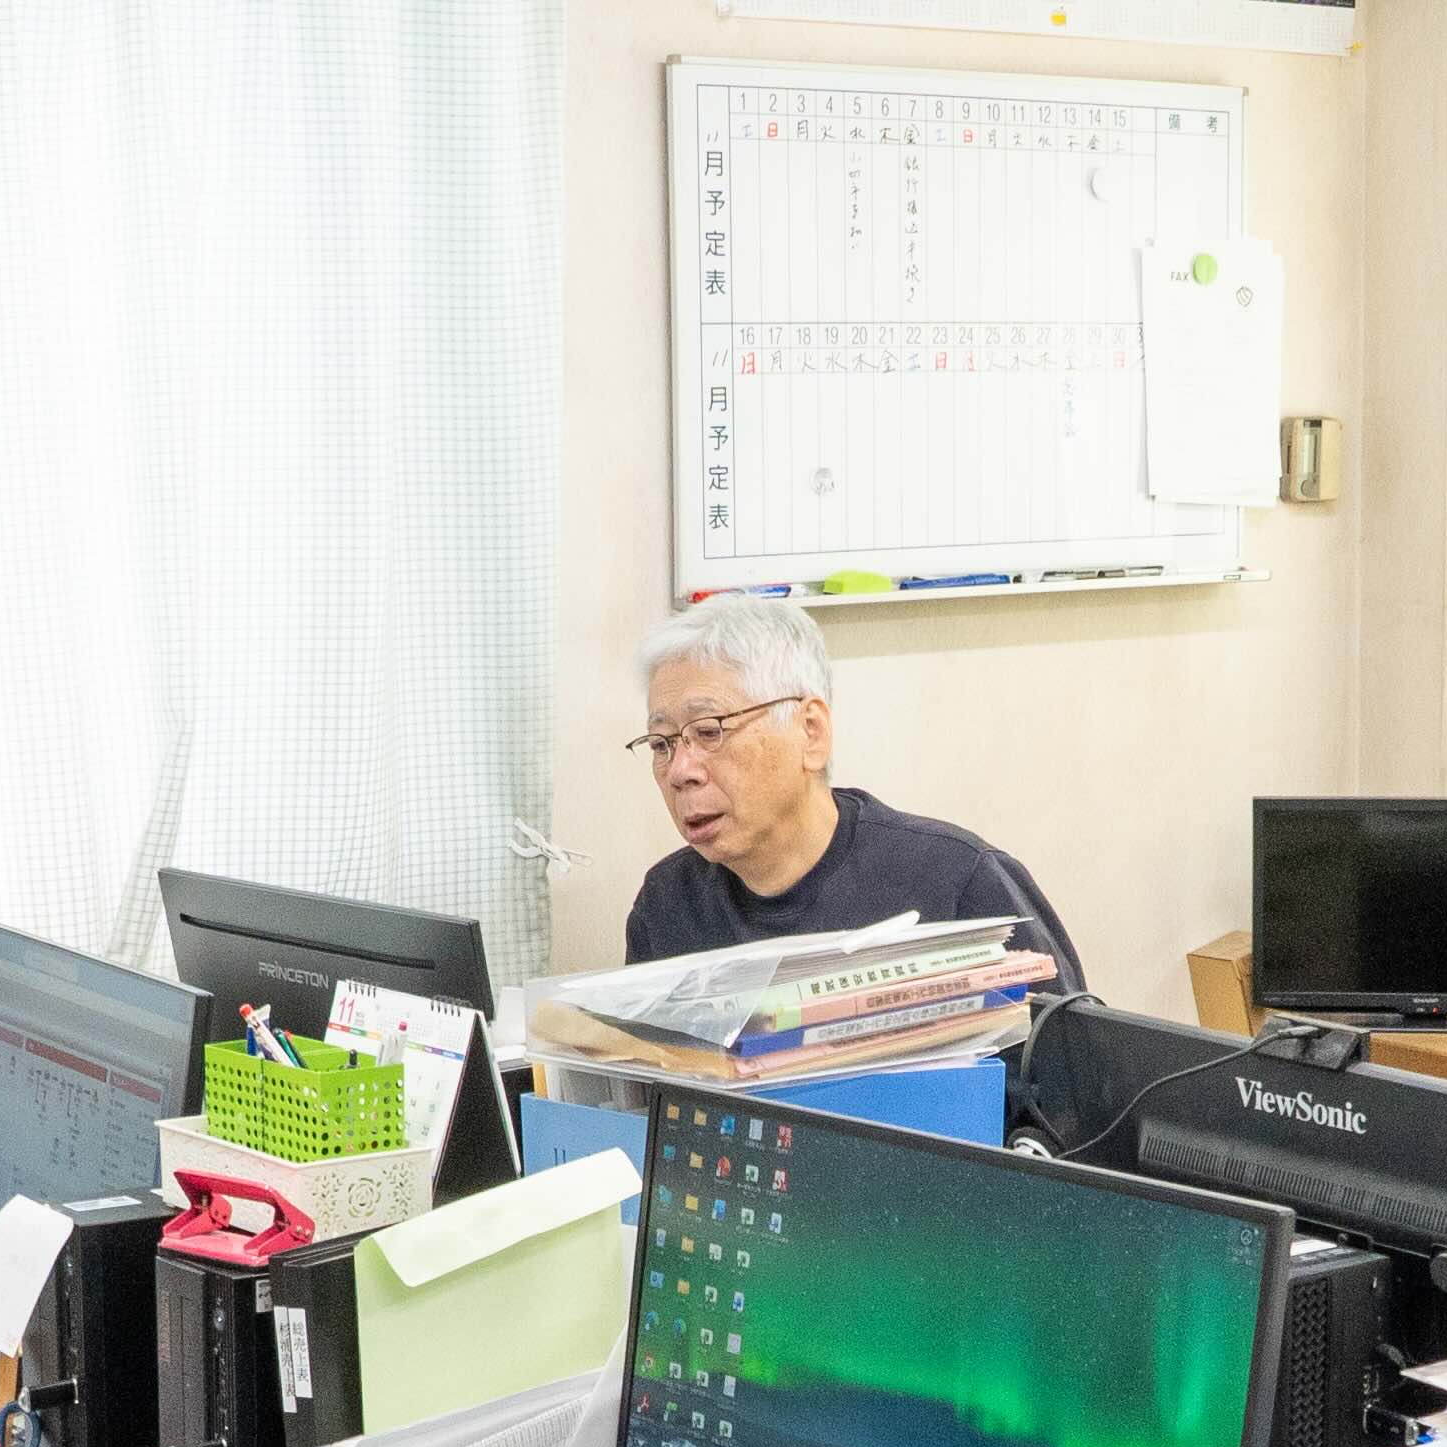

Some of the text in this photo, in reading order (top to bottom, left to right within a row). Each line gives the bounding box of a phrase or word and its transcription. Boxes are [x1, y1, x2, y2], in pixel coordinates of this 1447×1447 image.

[740, 92, 1126, 128] 1 2 3 4 5 6 7 8 9 10 11 12 13 14 15
[705, 151, 726, 295] 月予定表
[740, 327, 755, 345] 16
[769, 327, 782, 345] 17
[796, 327, 811, 345] 18
[825, 327, 839, 345] 19
[852, 327, 867, 345] 20
[879, 326, 894, 345] 21
[906, 326, 921, 345] 22
[933, 326, 947, 345] 23
[959, 326, 974, 345] 24
[985, 326, 1001, 345] 25
[1011, 326, 1025, 345] 26
[1037, 326, 1051, 345] 27
[708, 386, 729, 530] 月予定表
[257, 960, 330, 991] PRINCETON
[339, 997, 355, 1024] 11
[1234, 1077, 1367, 1135] ViewSonic
